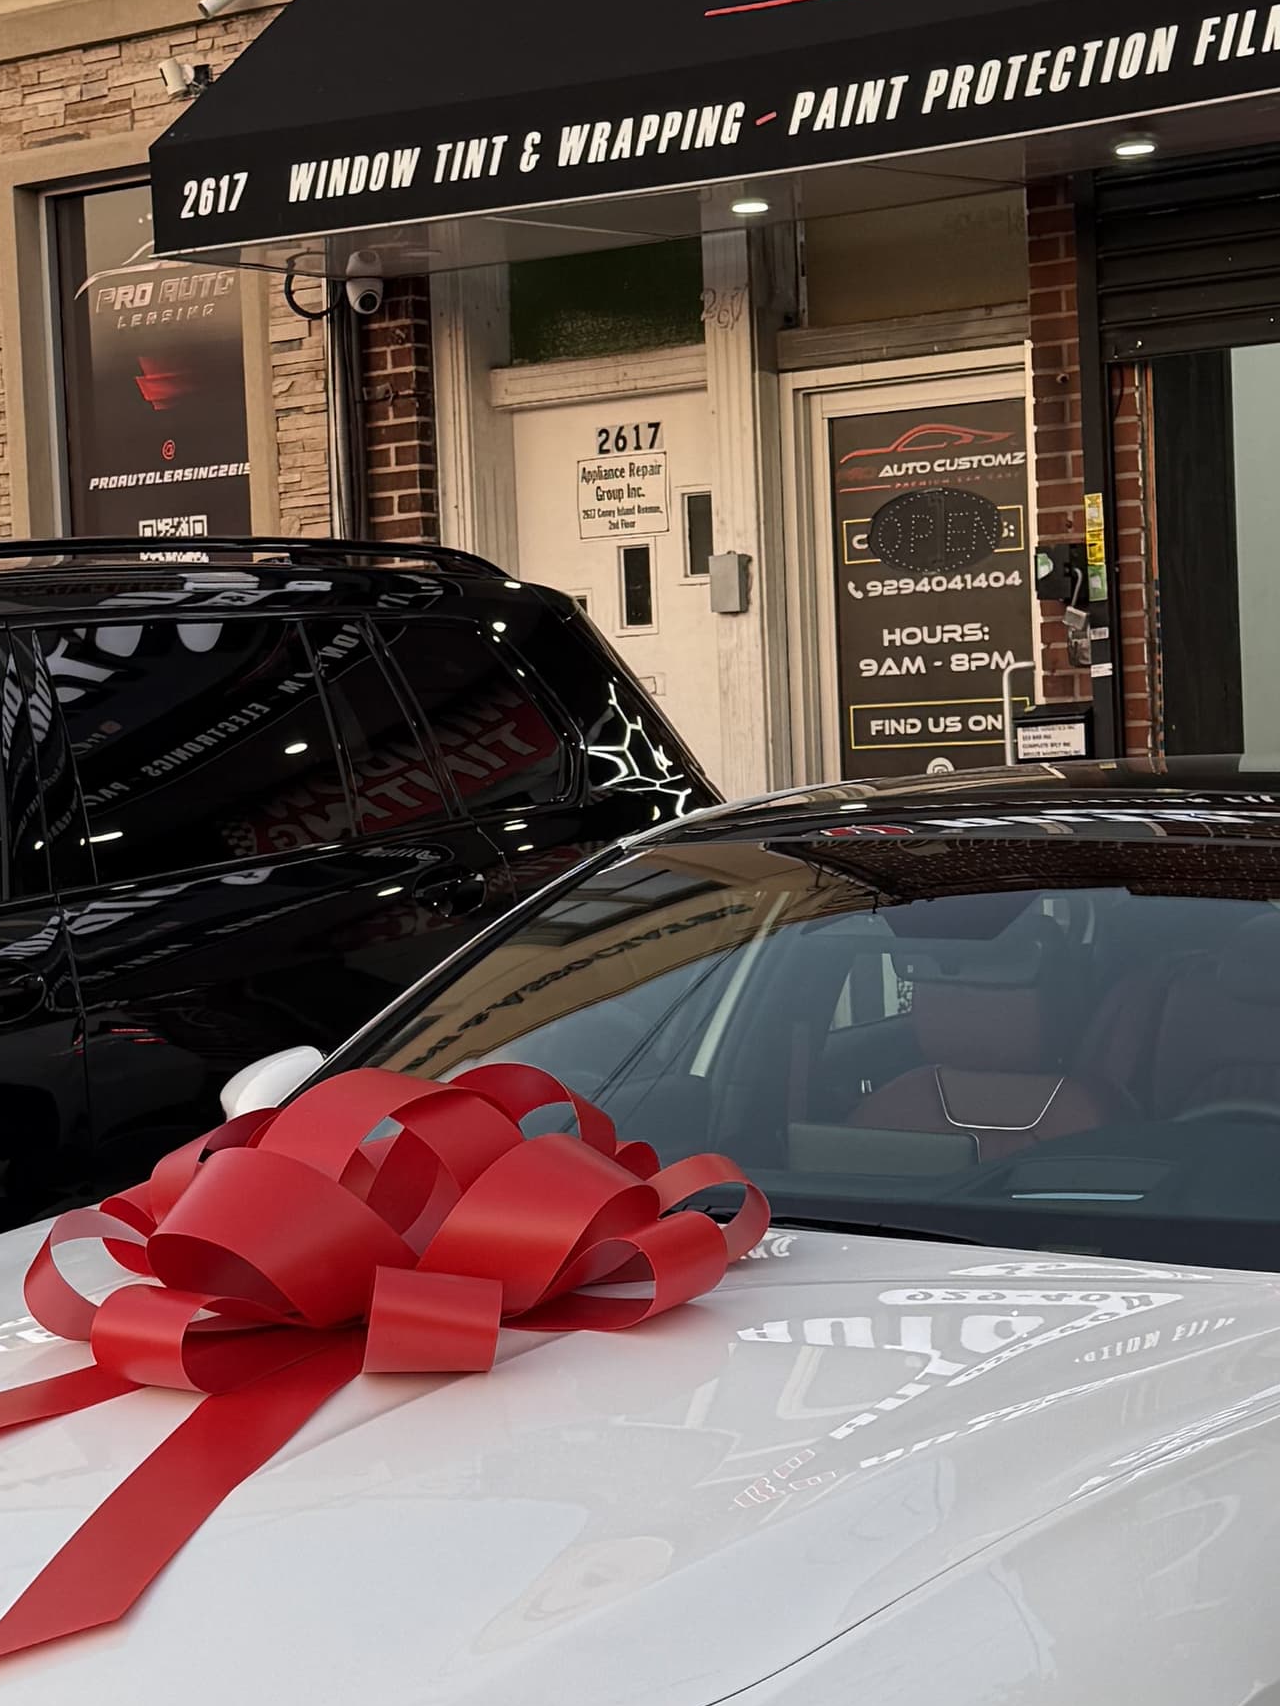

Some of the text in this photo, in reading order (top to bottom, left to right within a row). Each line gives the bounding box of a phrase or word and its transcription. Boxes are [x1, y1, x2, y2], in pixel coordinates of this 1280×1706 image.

[288, 144, 420, 205] WINDOW
[434, 135, 510, 183] TINT
[520, 131, 543, 174] &
[557, 105, 744, 170] WRAPPING
[788, 75, 910, 136] PAINT
[920, 26, 1180, 116] PROTECTION
[180, 172, 250, 220] 2617
[96, 270, 236, 314] PRO AUTO
[117, 303, 216, 329] LEASING
[597, 422, 661, 454] 2617
[581, 462, 662, 485] Appliance Repair
[879, 461, 930, 478] AUTO
[933, 451, 1026, 473] CUSTOMZ
[596, 485, 624, 503] Group
[878, 510, 996, 555] OPEN
[866, 570, 1023, 598] 9294041404
[882, 622, 990, 647] HOURS:
[859, 654, 927, 677] 9AM
[950, 650, 1016, 672] 8PM
[870, 714, 1003, 736] FIND US ON
